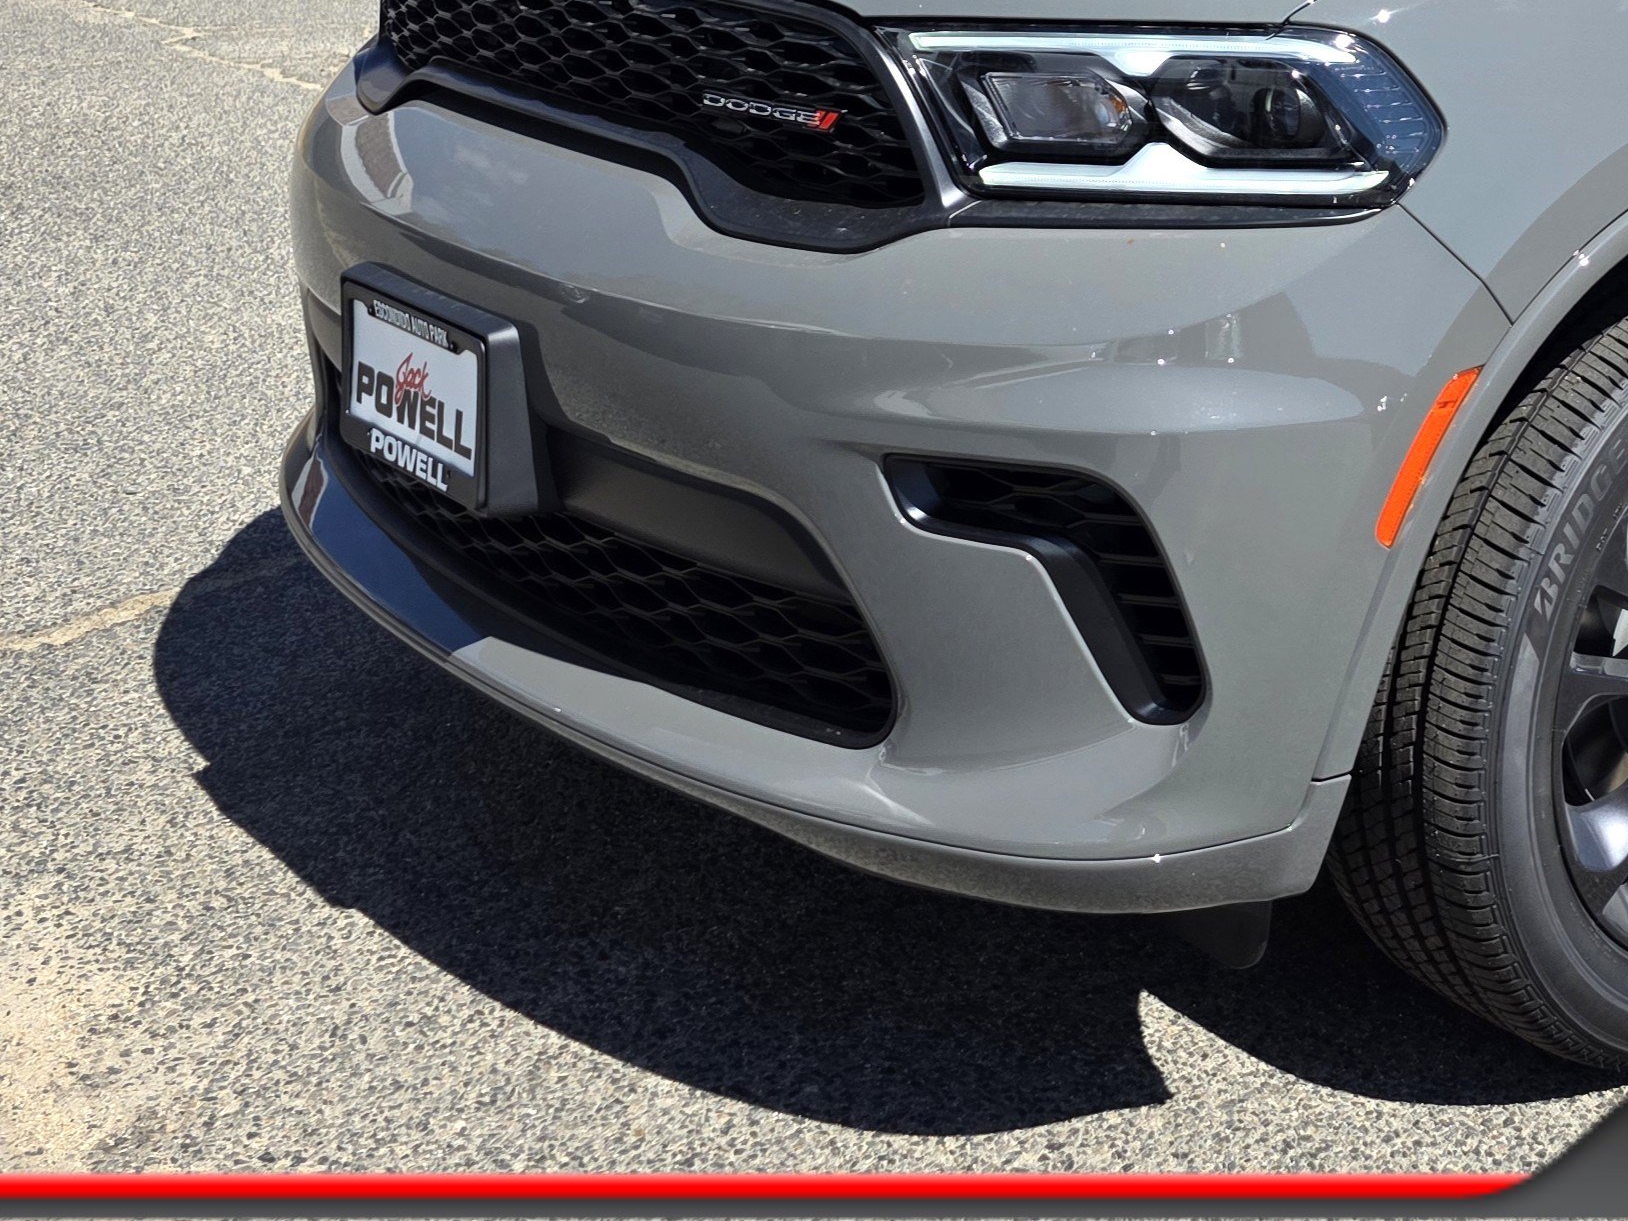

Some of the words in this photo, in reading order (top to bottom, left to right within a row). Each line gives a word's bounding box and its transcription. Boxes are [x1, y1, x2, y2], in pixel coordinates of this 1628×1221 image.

[703, 93, 820, 125] DODGE
[394, 352, 431, 405] Jack
[356, 361, 471, 460] POWELL
[370, 428, 448, 492] POWELL
